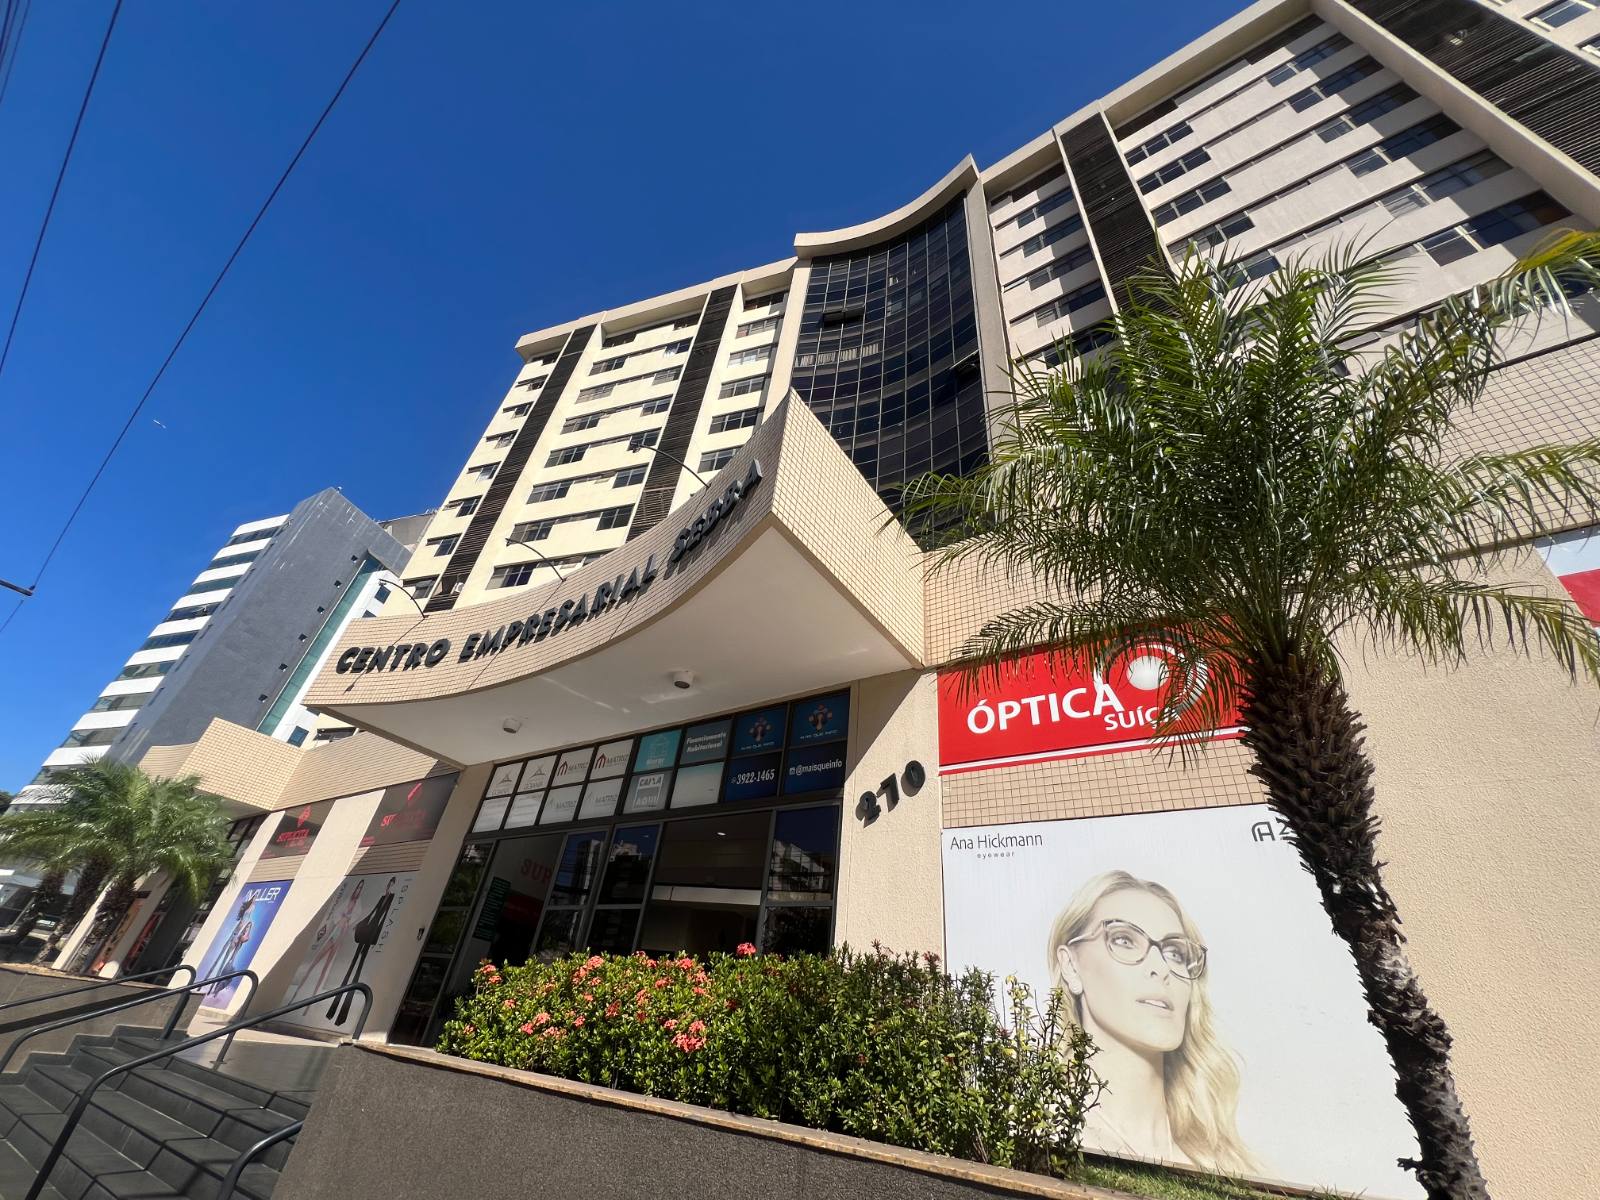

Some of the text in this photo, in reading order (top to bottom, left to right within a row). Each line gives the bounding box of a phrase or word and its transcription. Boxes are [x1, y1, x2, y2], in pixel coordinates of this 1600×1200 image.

[336, 638, 451, 675] CENTRO
[459, 553, 657, 664] EMPRESARIAL
[967, 682, 1125, 735] ÓPTICA
[857, 760, 925, 824] 270
[950, 832, 1043, 850] Ana Hickmann
[977, 852, 1015, 860] eyewear
